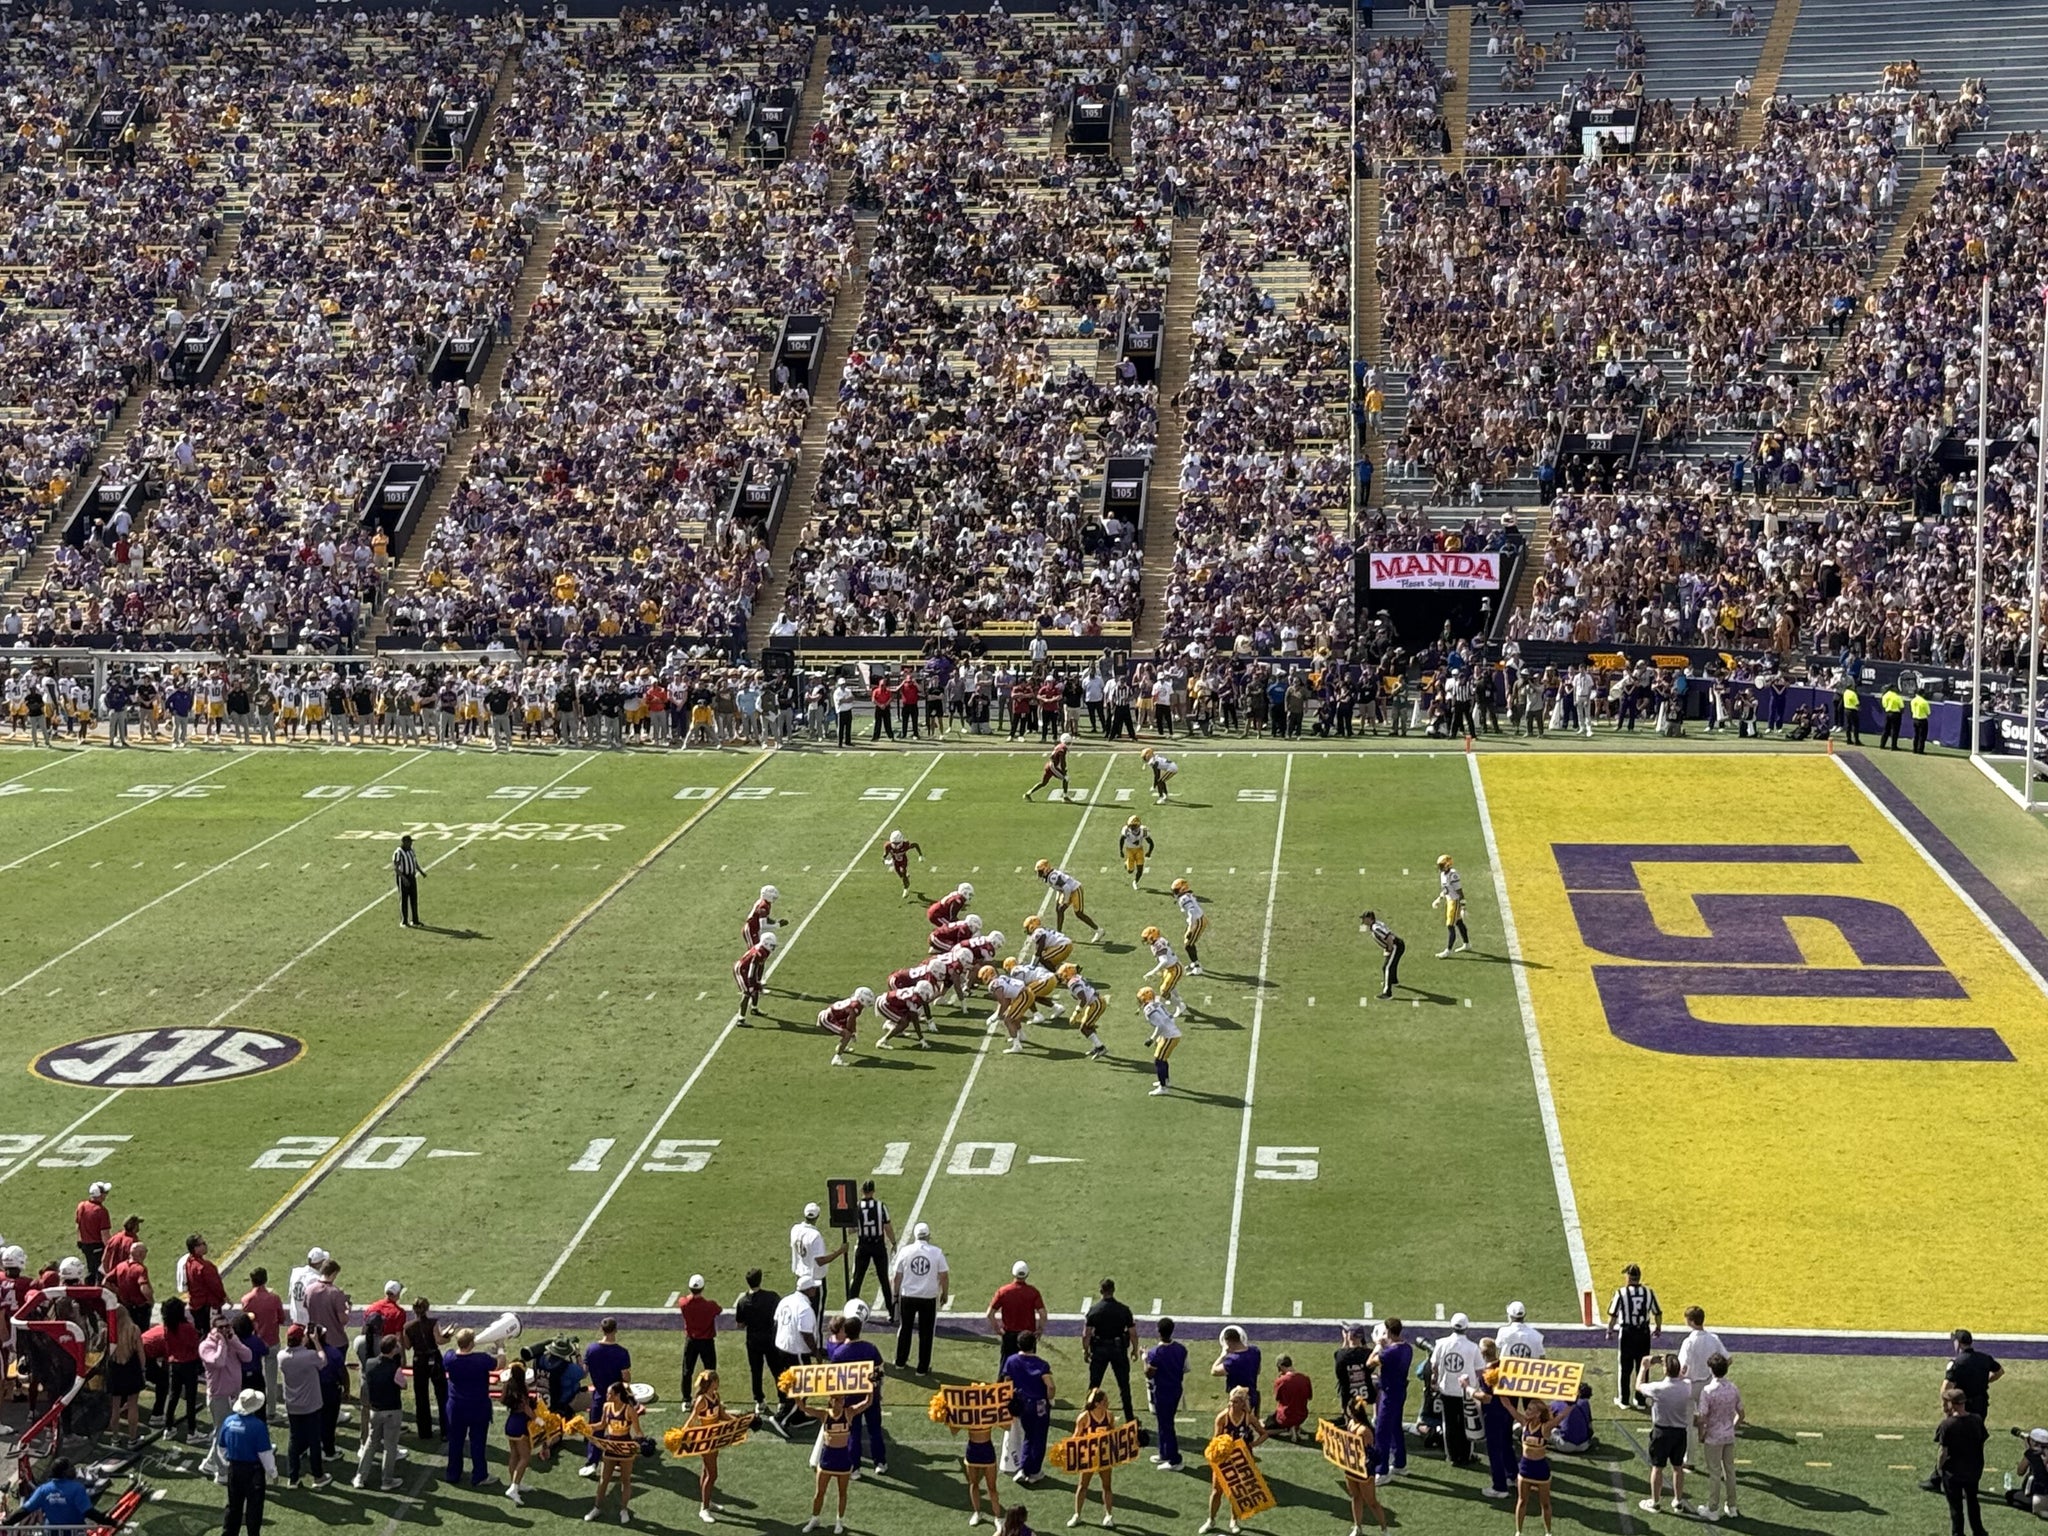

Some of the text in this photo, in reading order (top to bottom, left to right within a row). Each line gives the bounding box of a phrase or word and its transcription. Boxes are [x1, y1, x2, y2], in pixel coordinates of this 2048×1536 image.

[1084, 109, 1099, 118] 105
[1593, 114, 1609, 123] 223
[188, 343, 203, 352] 103
[455, 343, 471, 352] 103
[790, 341, 807, 350] 104
[1132, 339, 1149, 348] 105
[1590, 440, 1606, 450] 221
[751, 492, 767, 500] 104
[1116, 489, 1132, 498] 105
[1372, 555, 1494, 583] MANDA
[302, 785, 408, 798] 30
[486, 786, 592, 799] 25
[673, 787, 776, 800] 20
[858, 787, 950, 801] 15
[1236, 789, 1278, 802] 5
[334, 830, 610, 841] VENTURE
[402, 822, 626, 833] GLOBAL
[1550, 843, 2018, 1062] LSU
[49, 1028, 287, 1086] SEC
[249, 1136, 427, 1169] 20
[567, 1138, 723, 1172] 15
[871, 1142, 1018, 1175] 10
[1254, 1146, 1321, 1180] 5
[836, 1184, 848, 1210] 1
[862, 1208, 875, 1226] L
[911, 1256, 931, 1276] SEC
[1444, 1353, 1463, 1373] SEC
[1503, 1360, 1580, 1379] MAKE
[792, 1364, 869, 1393] DEFENSE
[1497, 1376, 1577, 1397] NOISE
[943, 1385, 1011, 1406] MAKE
[945, 1406, 1012, 1426] NOISE
[680, 1414, 754, 1442] MAKE
[677, 1429, 748, 1456] NOISE
[1066, 1426, 1138, 1471] DEFENSE
[1230, 1448, 1267, 1506] MAKE
